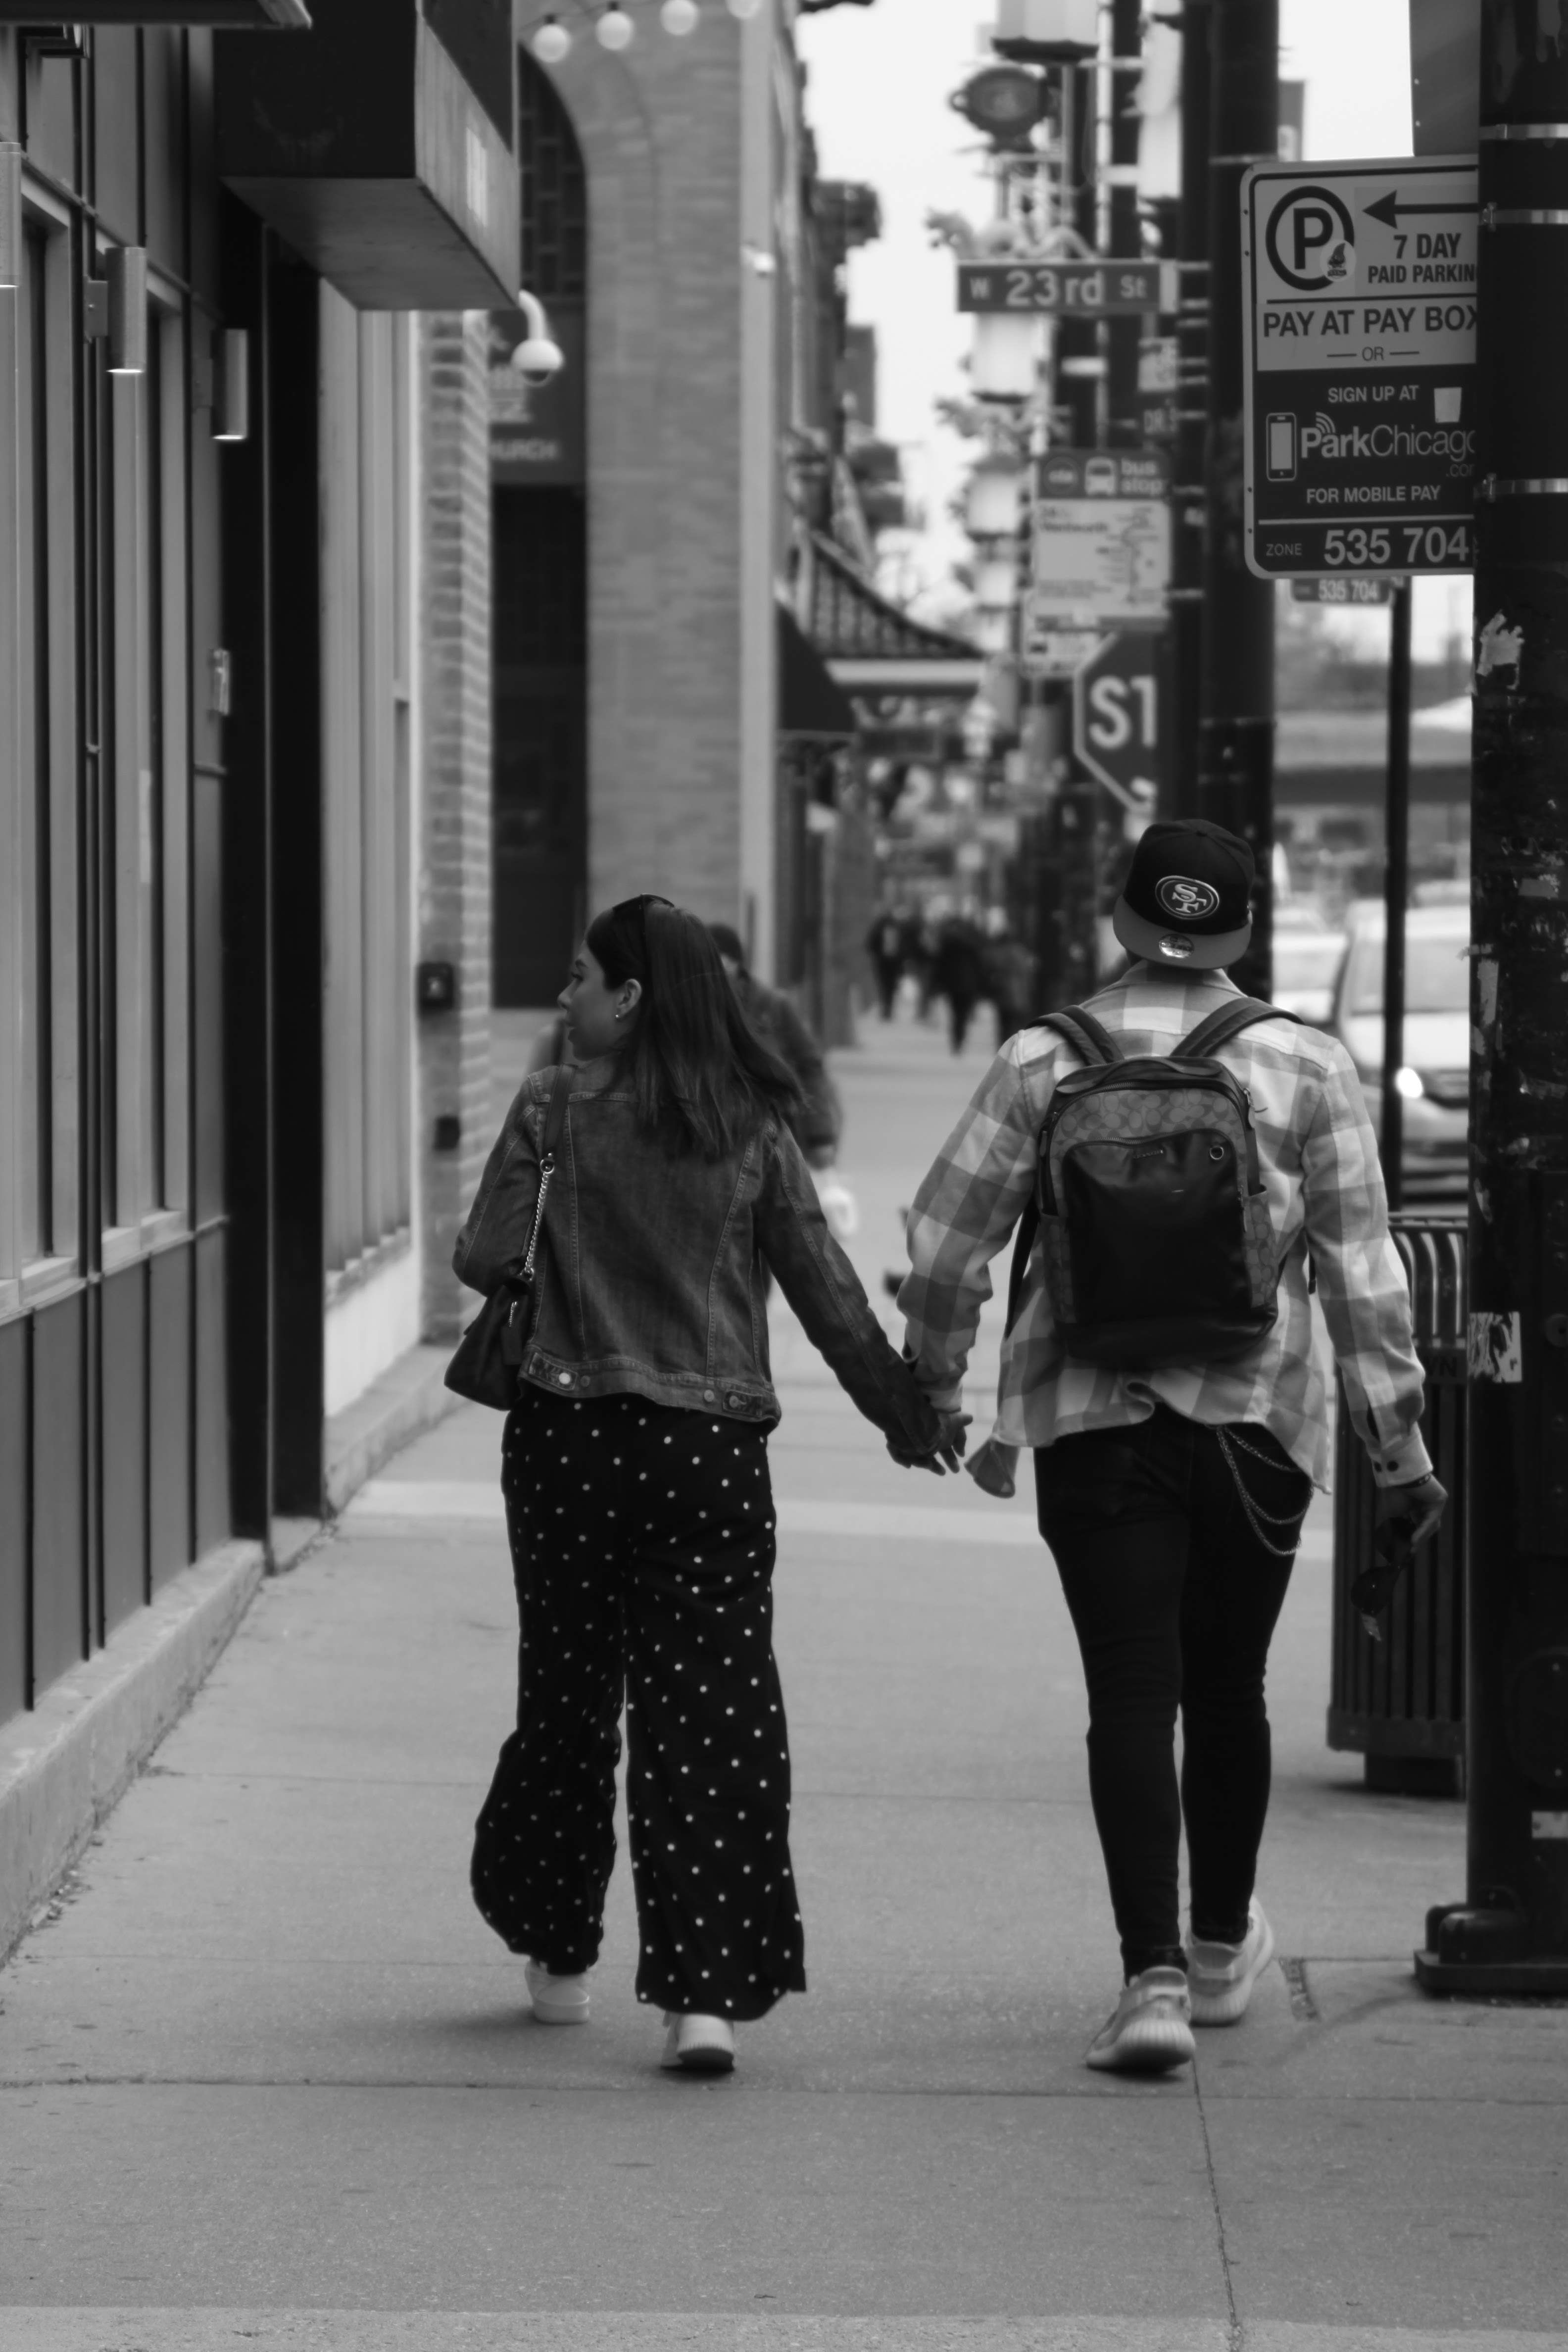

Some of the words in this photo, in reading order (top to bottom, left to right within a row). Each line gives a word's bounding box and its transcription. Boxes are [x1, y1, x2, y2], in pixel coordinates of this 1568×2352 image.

[1393, 234, 1408, 259] 7
[1417, 233, 1461, 258] DAY
[1368, 265, 1406, 284] PAID
[1413, 264, 1477, 283] PARKIN
[970, 276, 989, 299] W
[1005, 269, 1105, 307] 23rd
[1120, 274, 1147, 298] St
[1263, 310, 1315, 337] PAY
[1321, 309, 1355, 335] AT
[1364, 307, 1416, 333] PAY
[1362, 346, 1384, 361] OR
[1328, 386, 1367, 403] SIGN
[1372, 386, 1395, 402] UP
[1399, 385, 1419, 400] AT
[1307, 488, 1339, 504] FOR
[1344, 487, 1406, 502] MOBILE
[1411, 485, 1441, 501] PAY
[1266, 544, 1302, 556] ZONE
[1324, 528, 1390, 565] 535
[1403, 526, 1469, 563] 704
[1319, 578, 1346, 600] 535
[1351, 578, 1379, 600] 704
